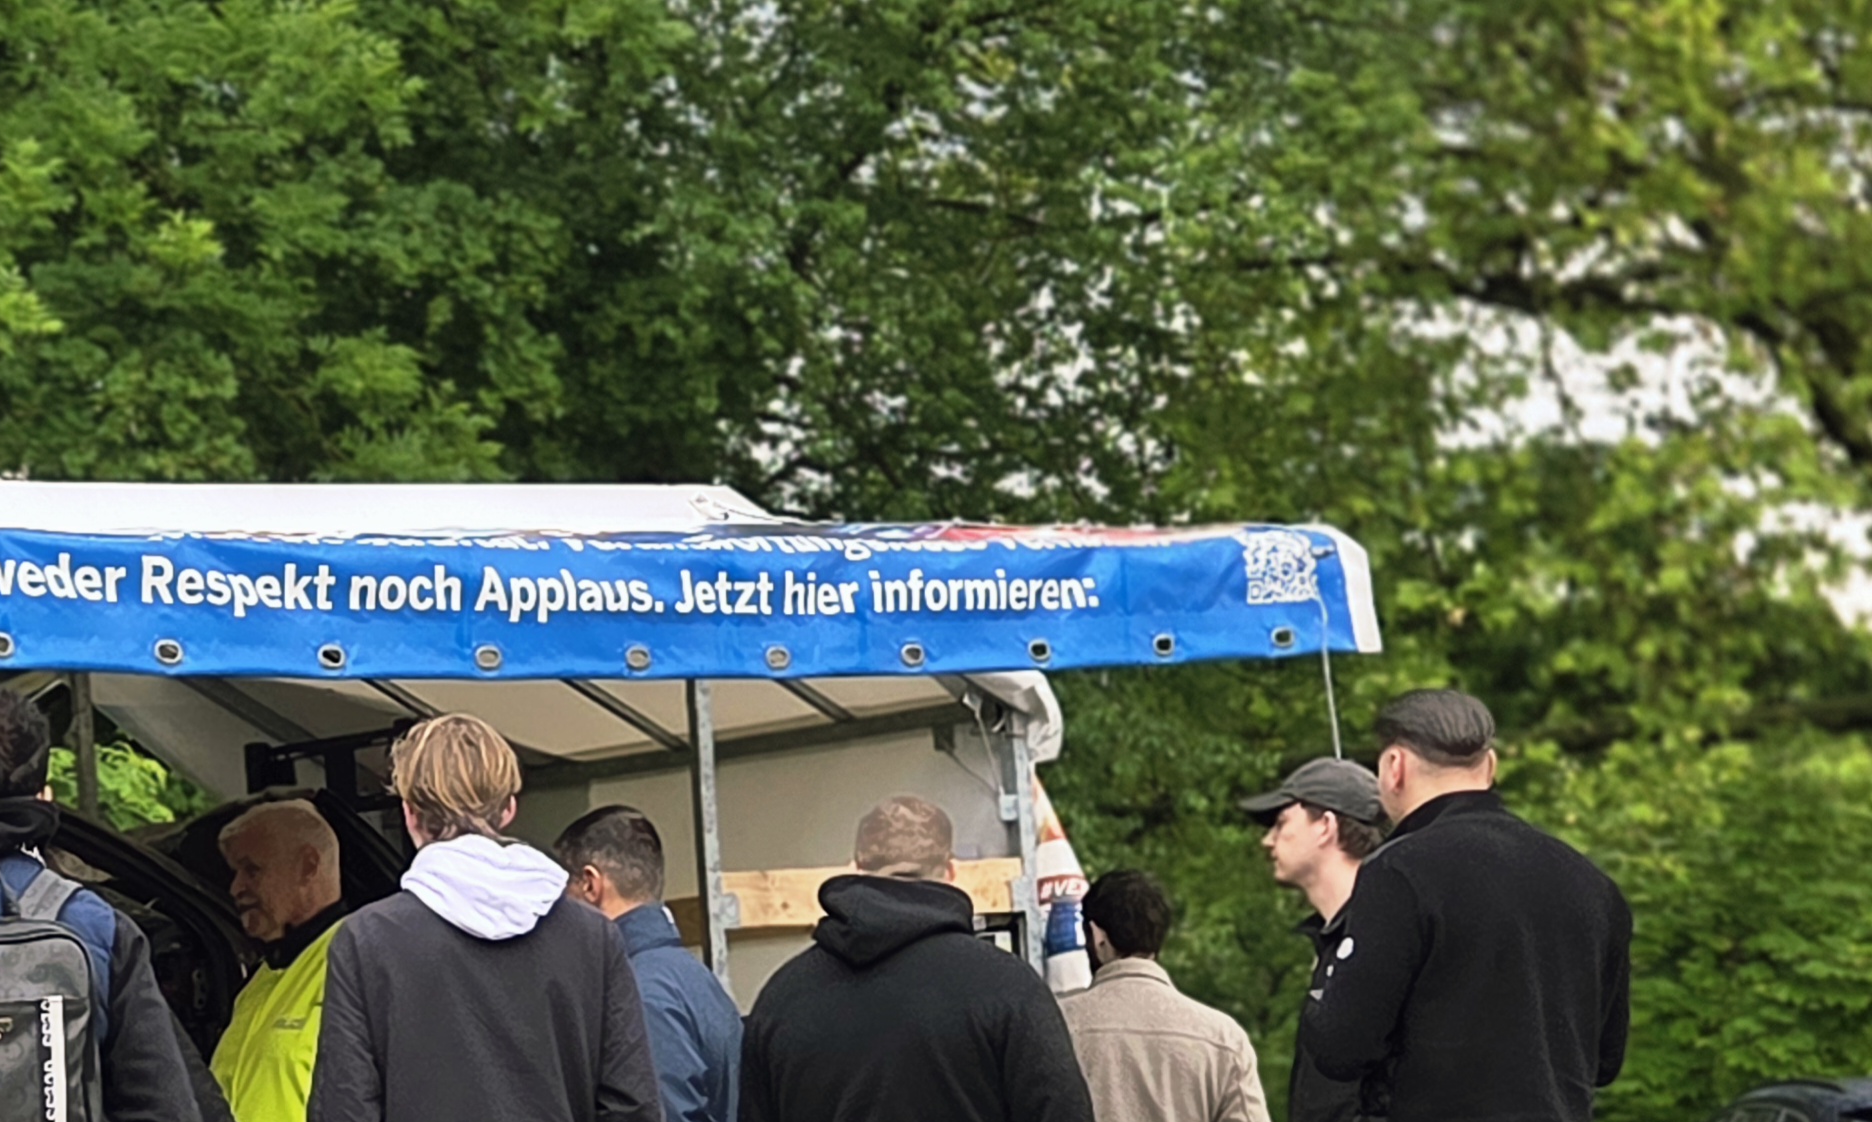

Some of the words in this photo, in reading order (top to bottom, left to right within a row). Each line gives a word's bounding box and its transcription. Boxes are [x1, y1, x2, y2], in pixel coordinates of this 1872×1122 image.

[141, 554, 336, 618] Respekt
[349, 565, 462, 611] noch
[474, 566, 665, 623] Applaus.
[675, 569, 774, 615] Jetzt
[784, 570, 859, 615] hier
[868, 568, 1100, 614] informieren:
